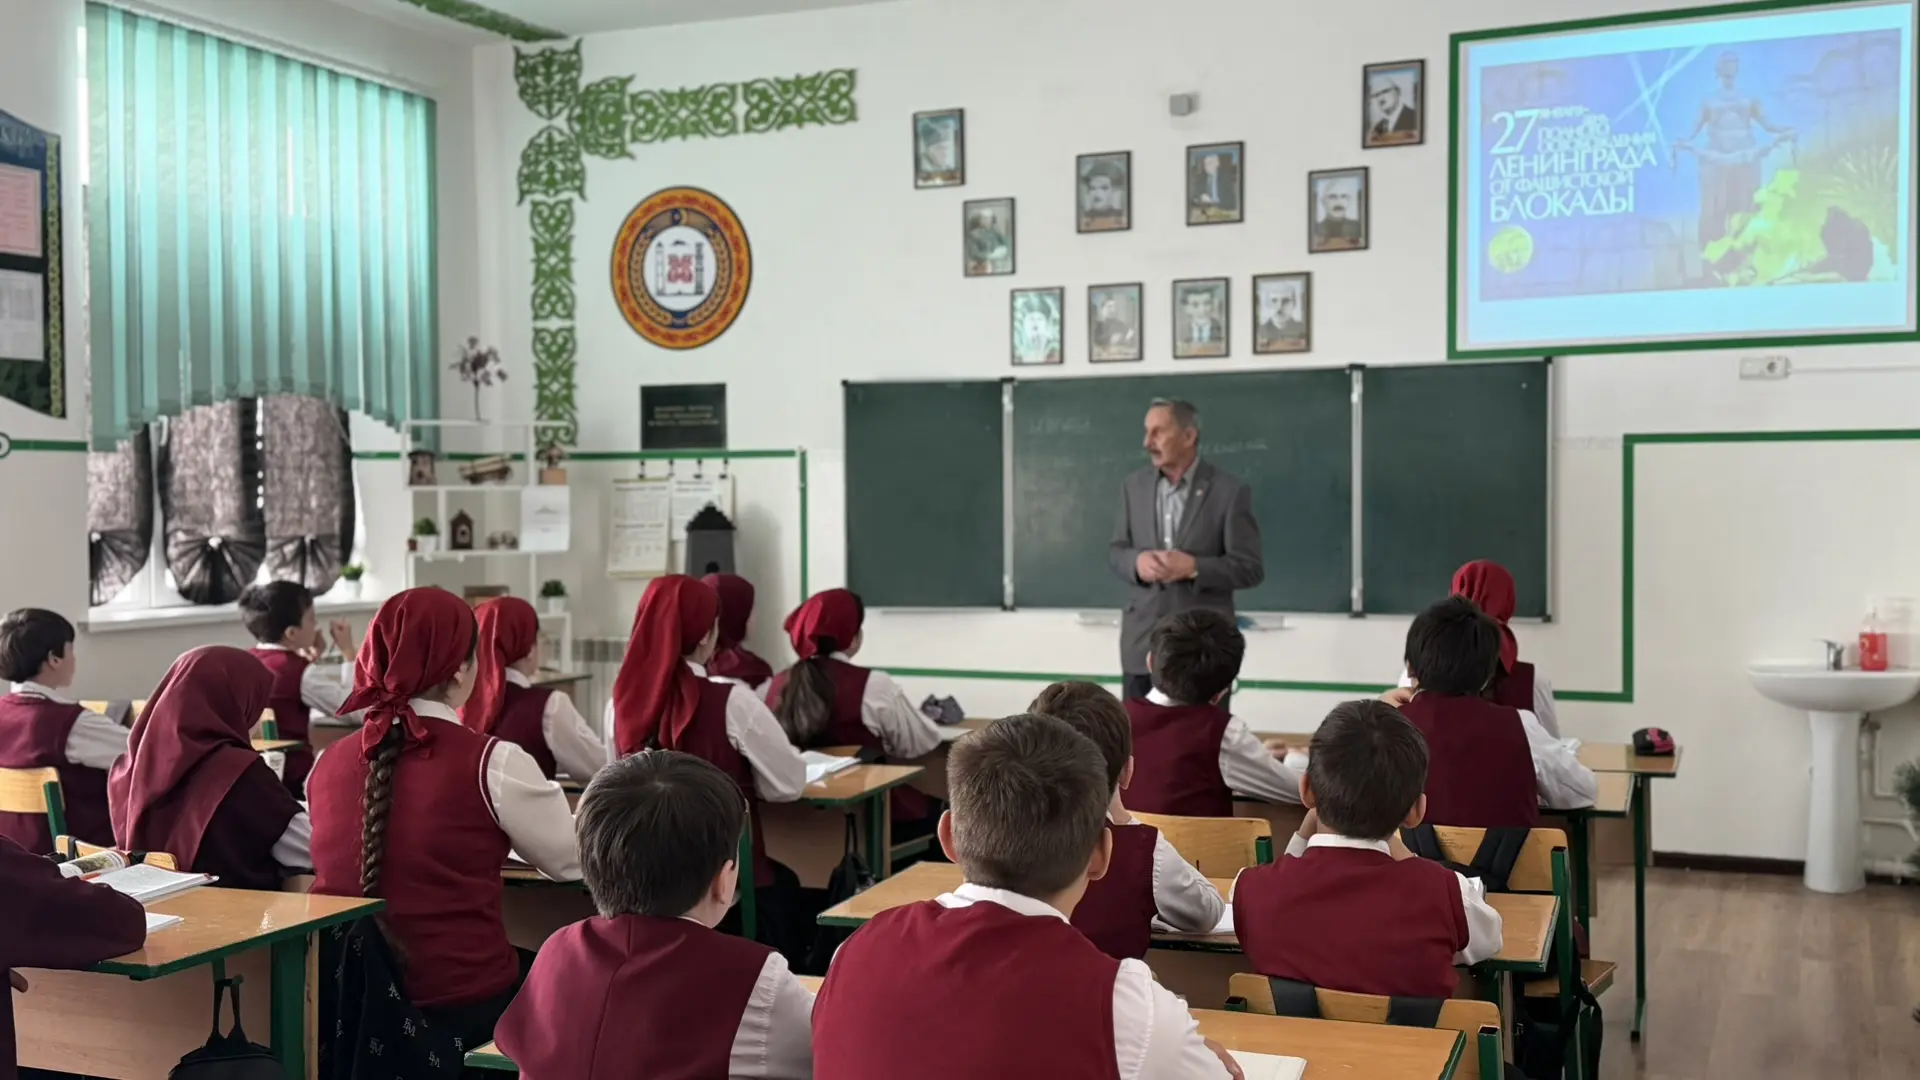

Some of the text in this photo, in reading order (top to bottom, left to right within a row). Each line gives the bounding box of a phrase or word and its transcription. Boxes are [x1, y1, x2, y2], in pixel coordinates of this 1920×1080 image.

[1490, 109, 1540, 155] 27
[1489, 145, 1658, 180] ЛЕНИНГРАДА
[1489, 178, 1512, 197] ОТ
[1490, 185, 1635, 223] БЛОКАДЫ
